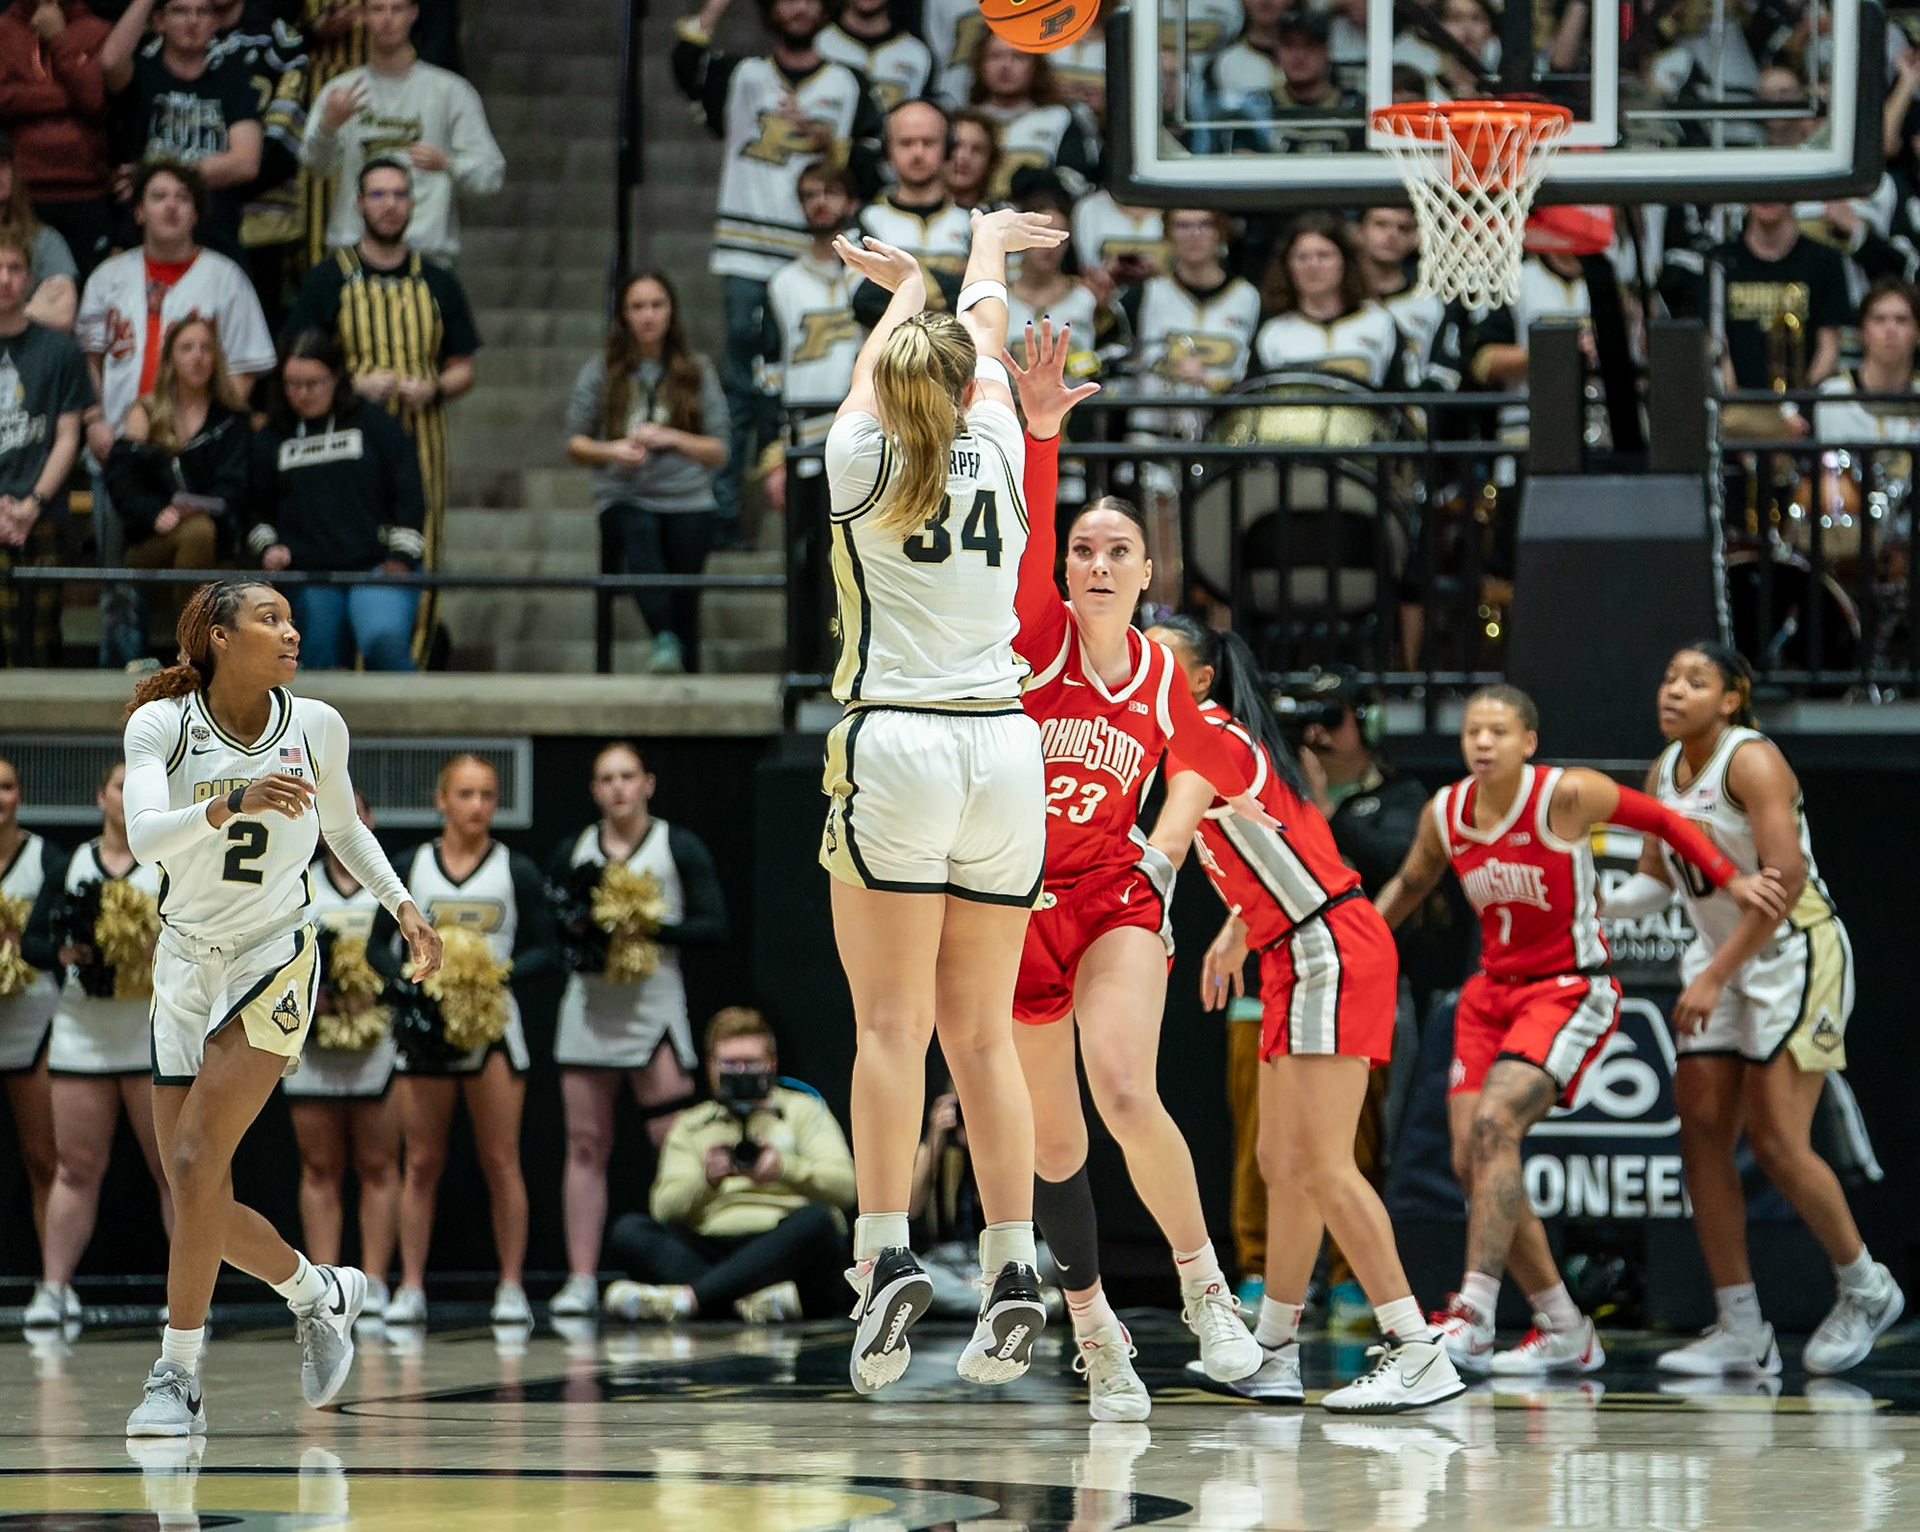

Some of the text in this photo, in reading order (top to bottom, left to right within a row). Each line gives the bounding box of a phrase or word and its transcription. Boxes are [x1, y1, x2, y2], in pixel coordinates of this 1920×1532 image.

[903, 488, 1004, 569] 34
[1083, 715, 1146, 796] STATE
[1045, 775, 1108, 824] 23
[222, 819, 269, 885] 2
[1495, 905, 1512, 947] 1
[1523, 1153, 1693, 1218] ONEE
